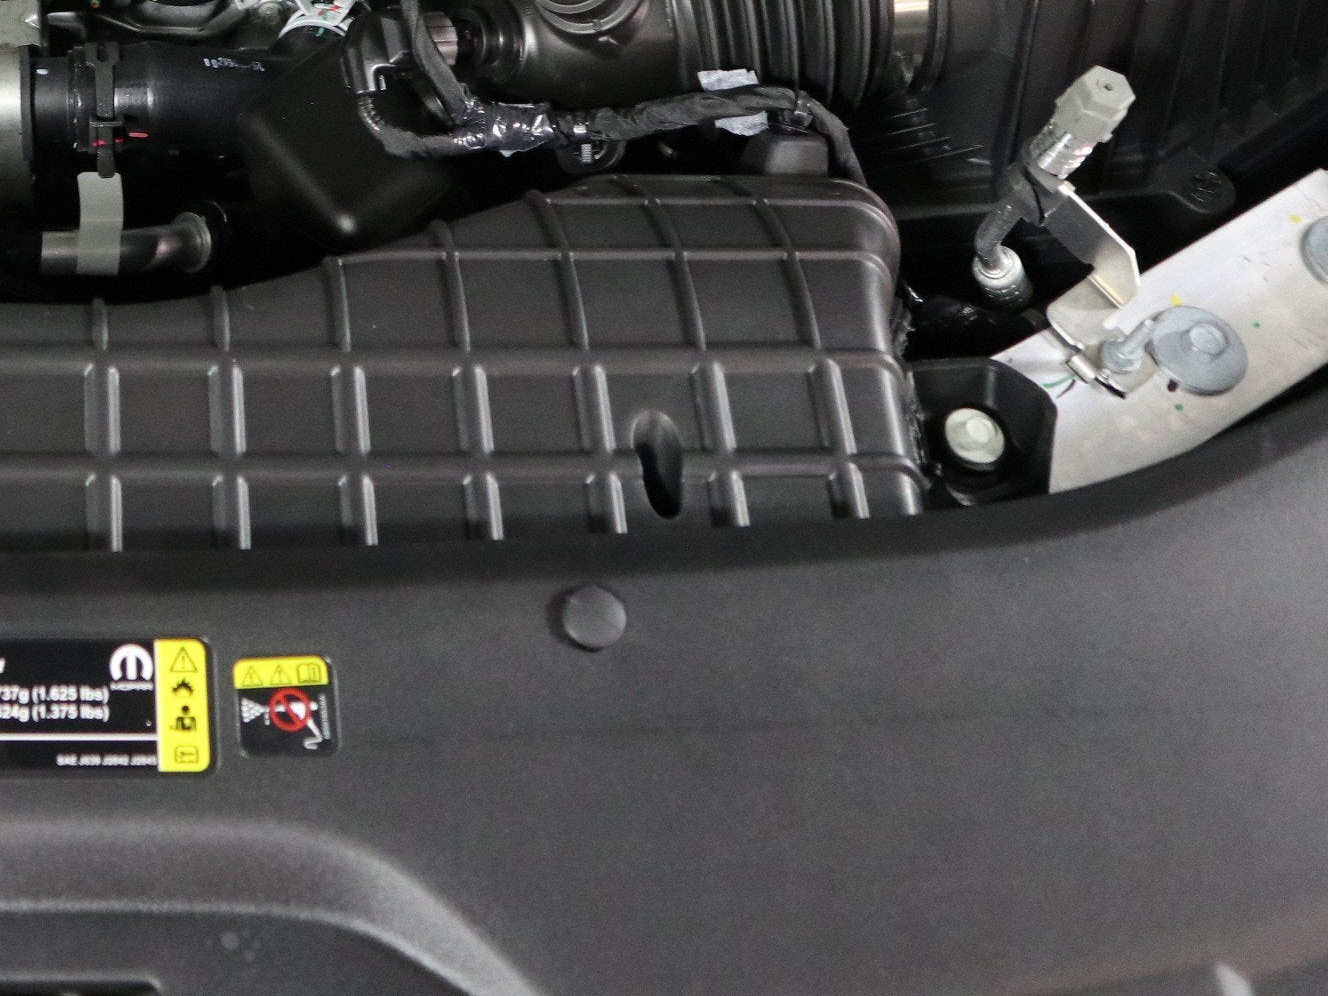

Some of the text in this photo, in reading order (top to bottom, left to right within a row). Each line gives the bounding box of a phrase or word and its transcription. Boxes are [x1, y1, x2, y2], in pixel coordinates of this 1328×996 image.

[31, 685, 78, 704] (1.625
[79, 685, 110, 704] lbs)
[31, 704, 78, 722] (1.375
[79, 704, 110, 722] lbs)
[56, 753, 78, 766] SAE
